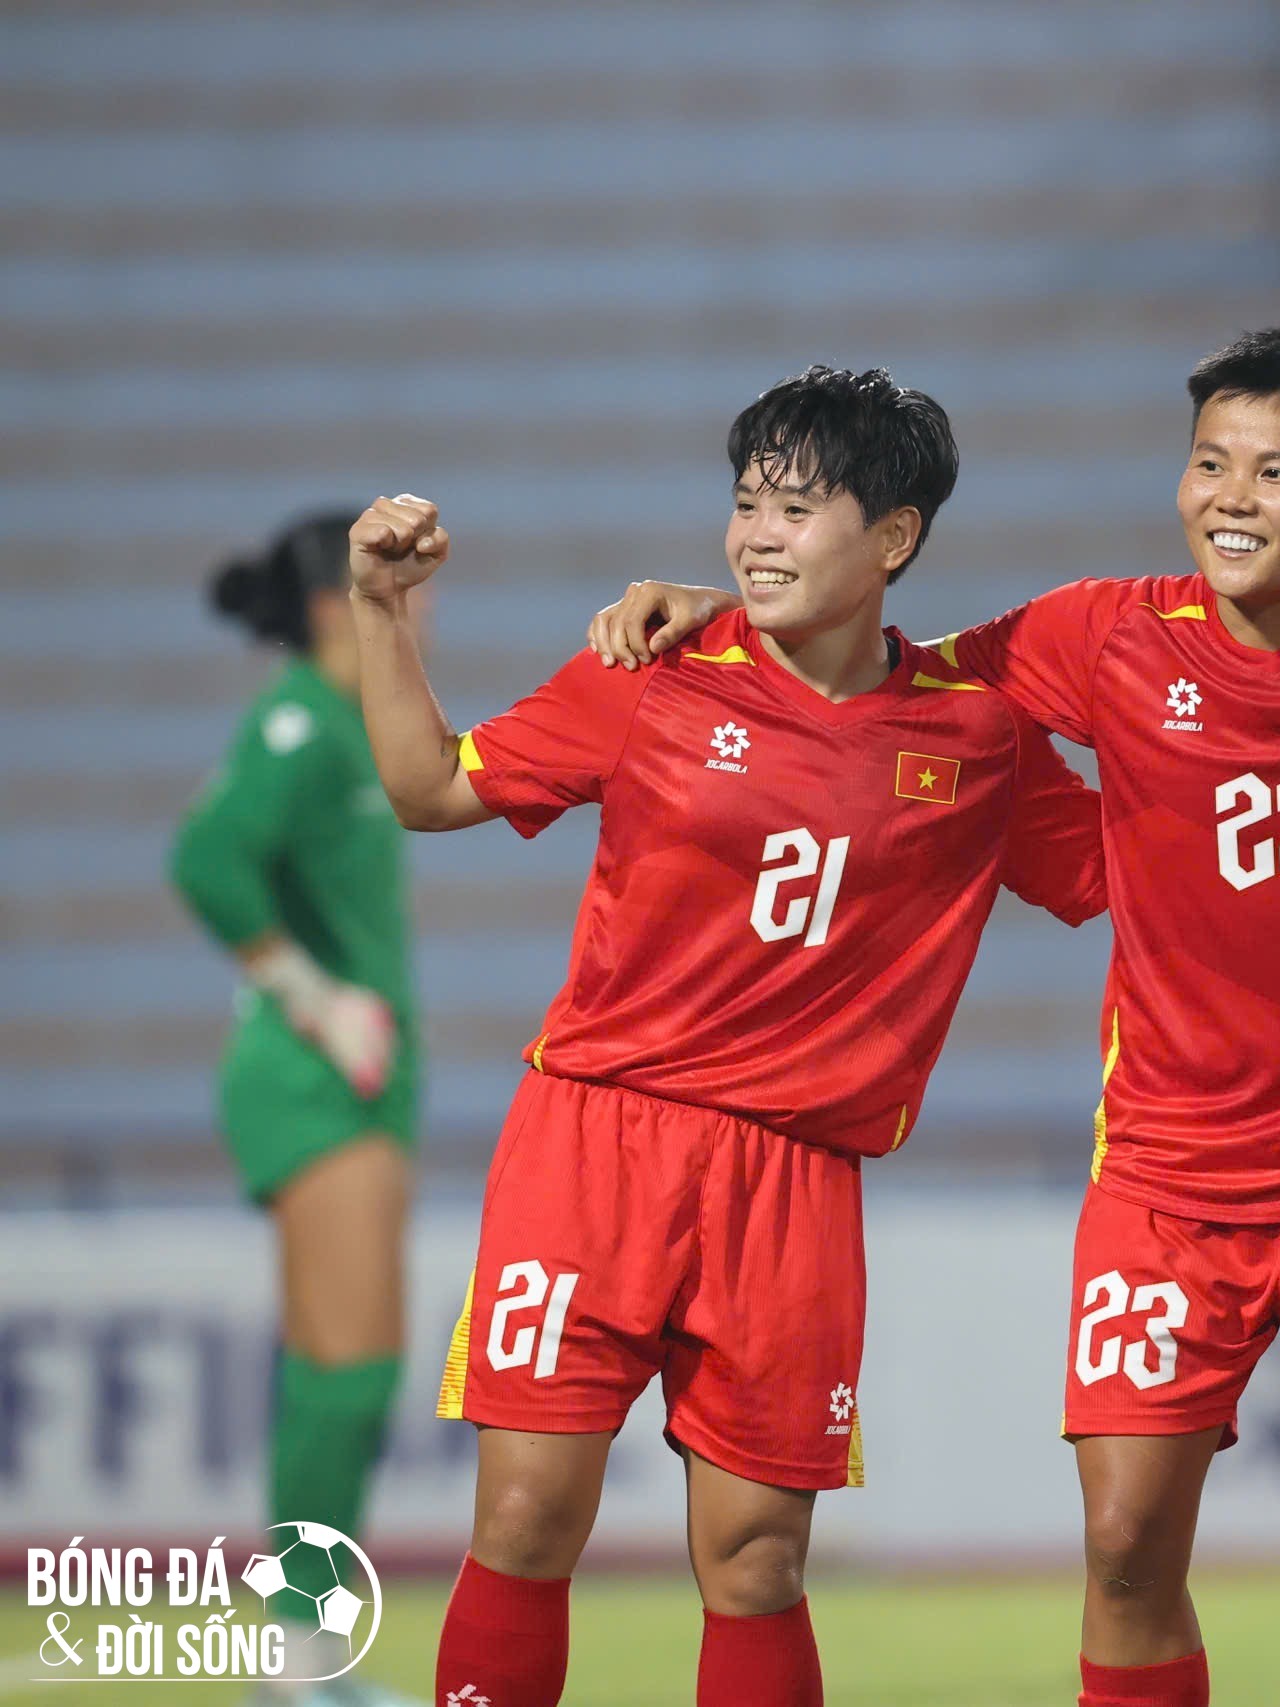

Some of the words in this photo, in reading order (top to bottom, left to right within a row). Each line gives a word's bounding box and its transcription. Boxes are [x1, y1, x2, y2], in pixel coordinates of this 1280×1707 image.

[749, 827, 851, 948] 21
[486, 1259, 580, 1379] 21
[1075, 1269, 1190, 1390] 23
